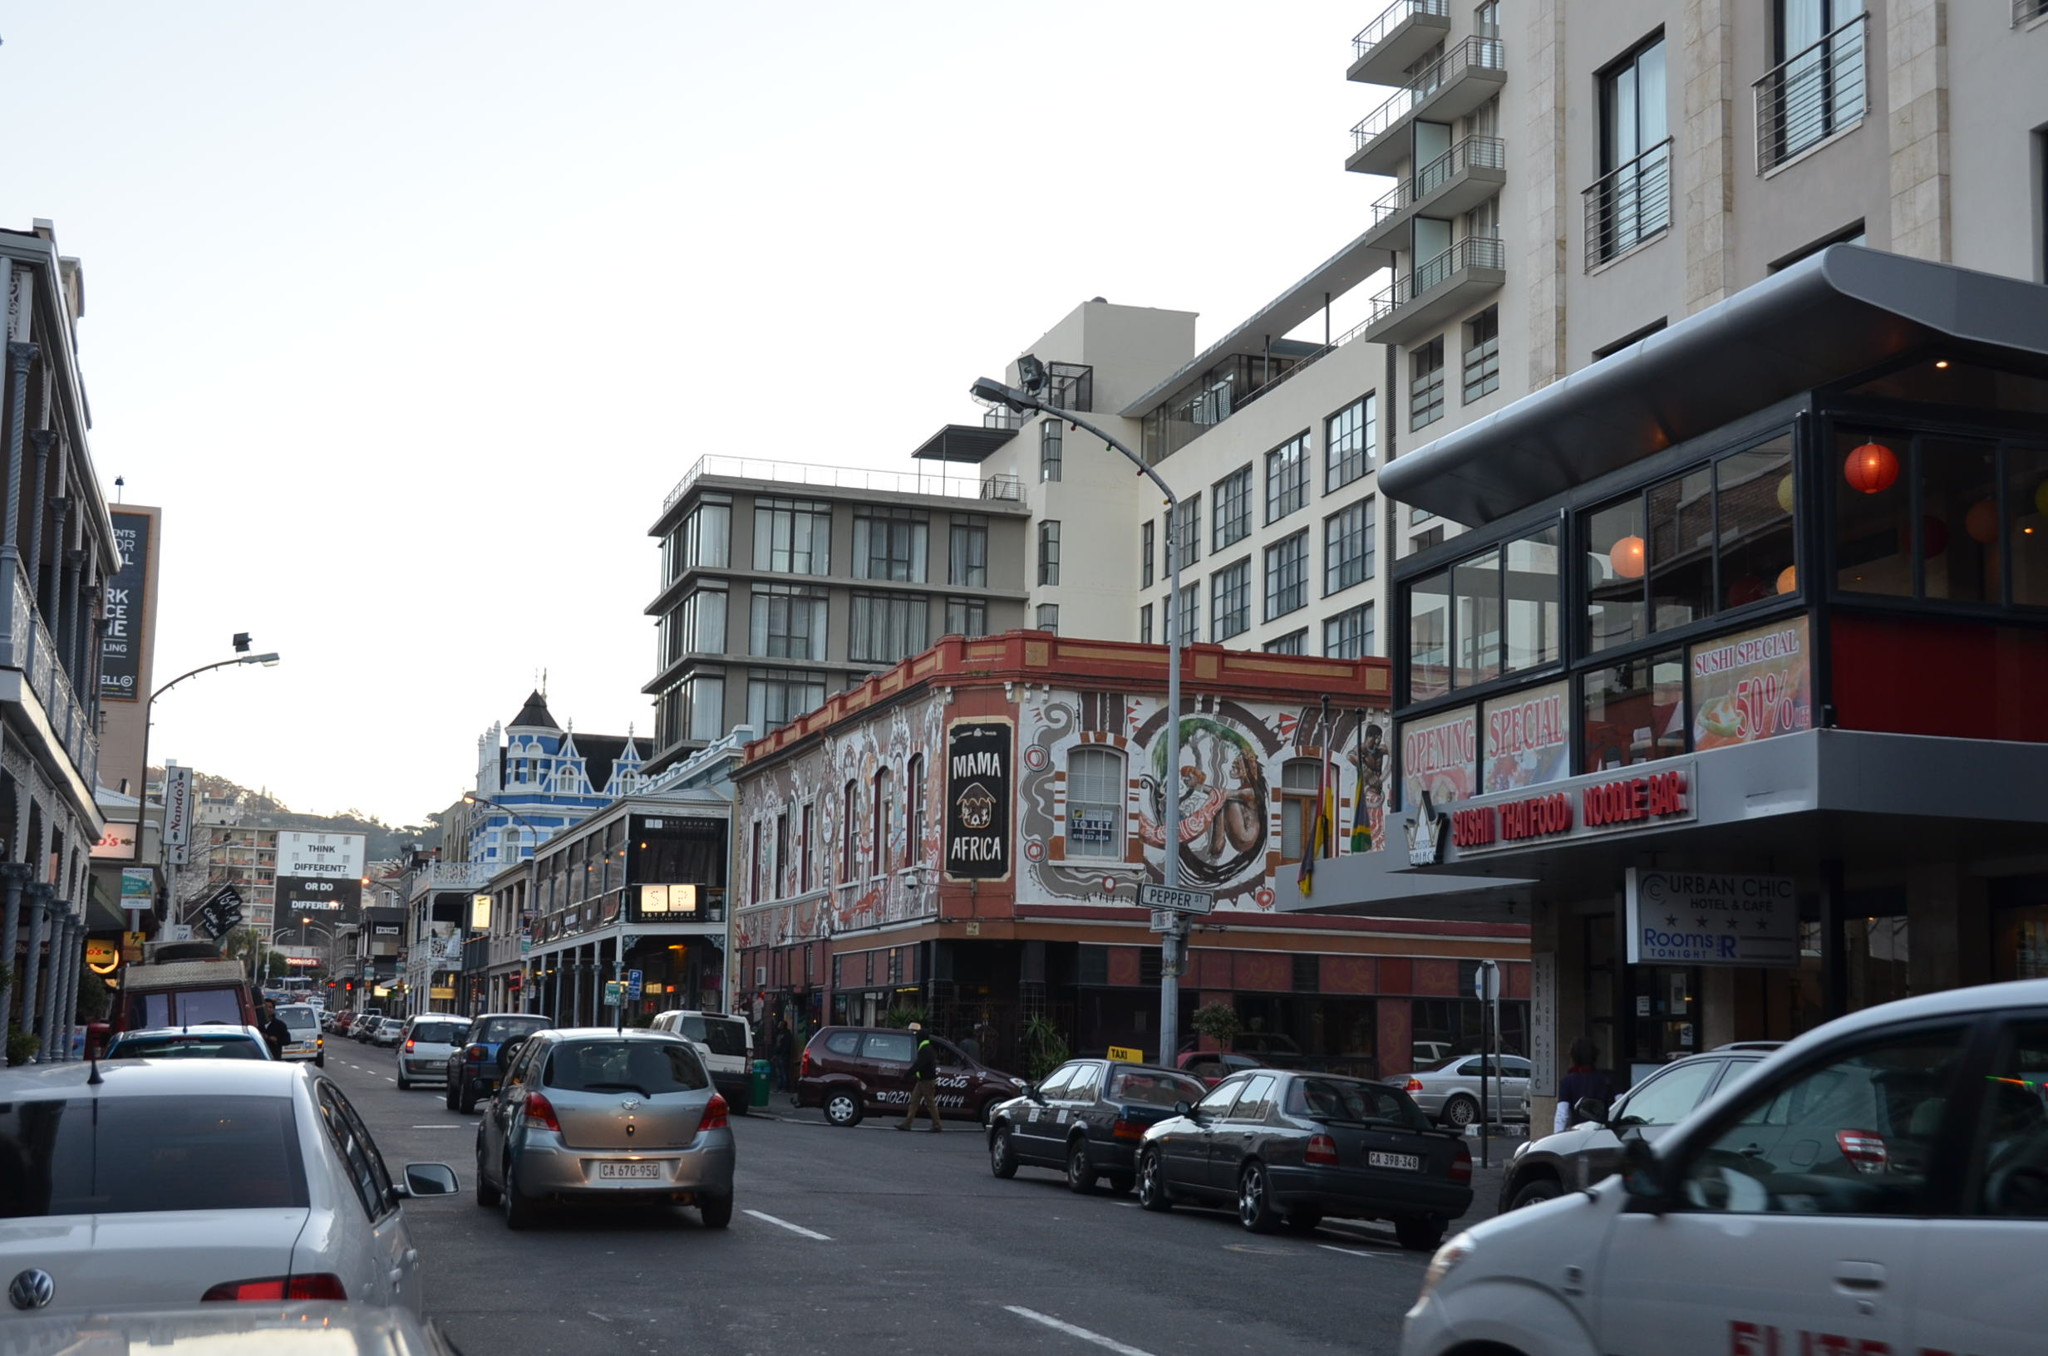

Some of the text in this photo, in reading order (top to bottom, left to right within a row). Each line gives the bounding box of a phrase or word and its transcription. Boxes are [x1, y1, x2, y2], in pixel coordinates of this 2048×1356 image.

[113, 529, 136, 538] ENTS
[107, 588, 129, 604] RK
[106, 604, 127, 618] CE
[103, 643, 127, 653] LING
[1695, 629, 1799, 677] SUSHI SPECIAL
[1735, 670, 1793, 738] 50%
[1405, 695, 1564, 778] OPENING SPECIAL
[953, 751, 1001, 780] MAMA
[171, 781, 185, 832] Nando's
[1453, 806, 1494, 848] SUSHI
[1583, 778, 1648, 827] NOODLE
[1649, 770, 1687, 816] BAR
[308, 845, 336, 854] THINK
[951, 836, 1001, 861] AFRICA
[294, 863, 347, 873] DIFFERENT?
[305, 882, 334, 892] OR DO
[1670, 875, 1792, 898] URBAN CHIC
[1150, 889, 1192, 908] PEPPER
[1690, 898, 1729, 910] HOTEL
[1644, 928, 1714, 948] Rooms
[1651, 949, 1706, 959] TONIGHT
[286, 957, 317, 966] Donald's
[1111, 1049, 1127, 1060] TAXI
[935, 1074, 970, 1088] xcite
[1370, 1153, 1381, 1165] CA
[602, 1165, 615, 1177] CA
